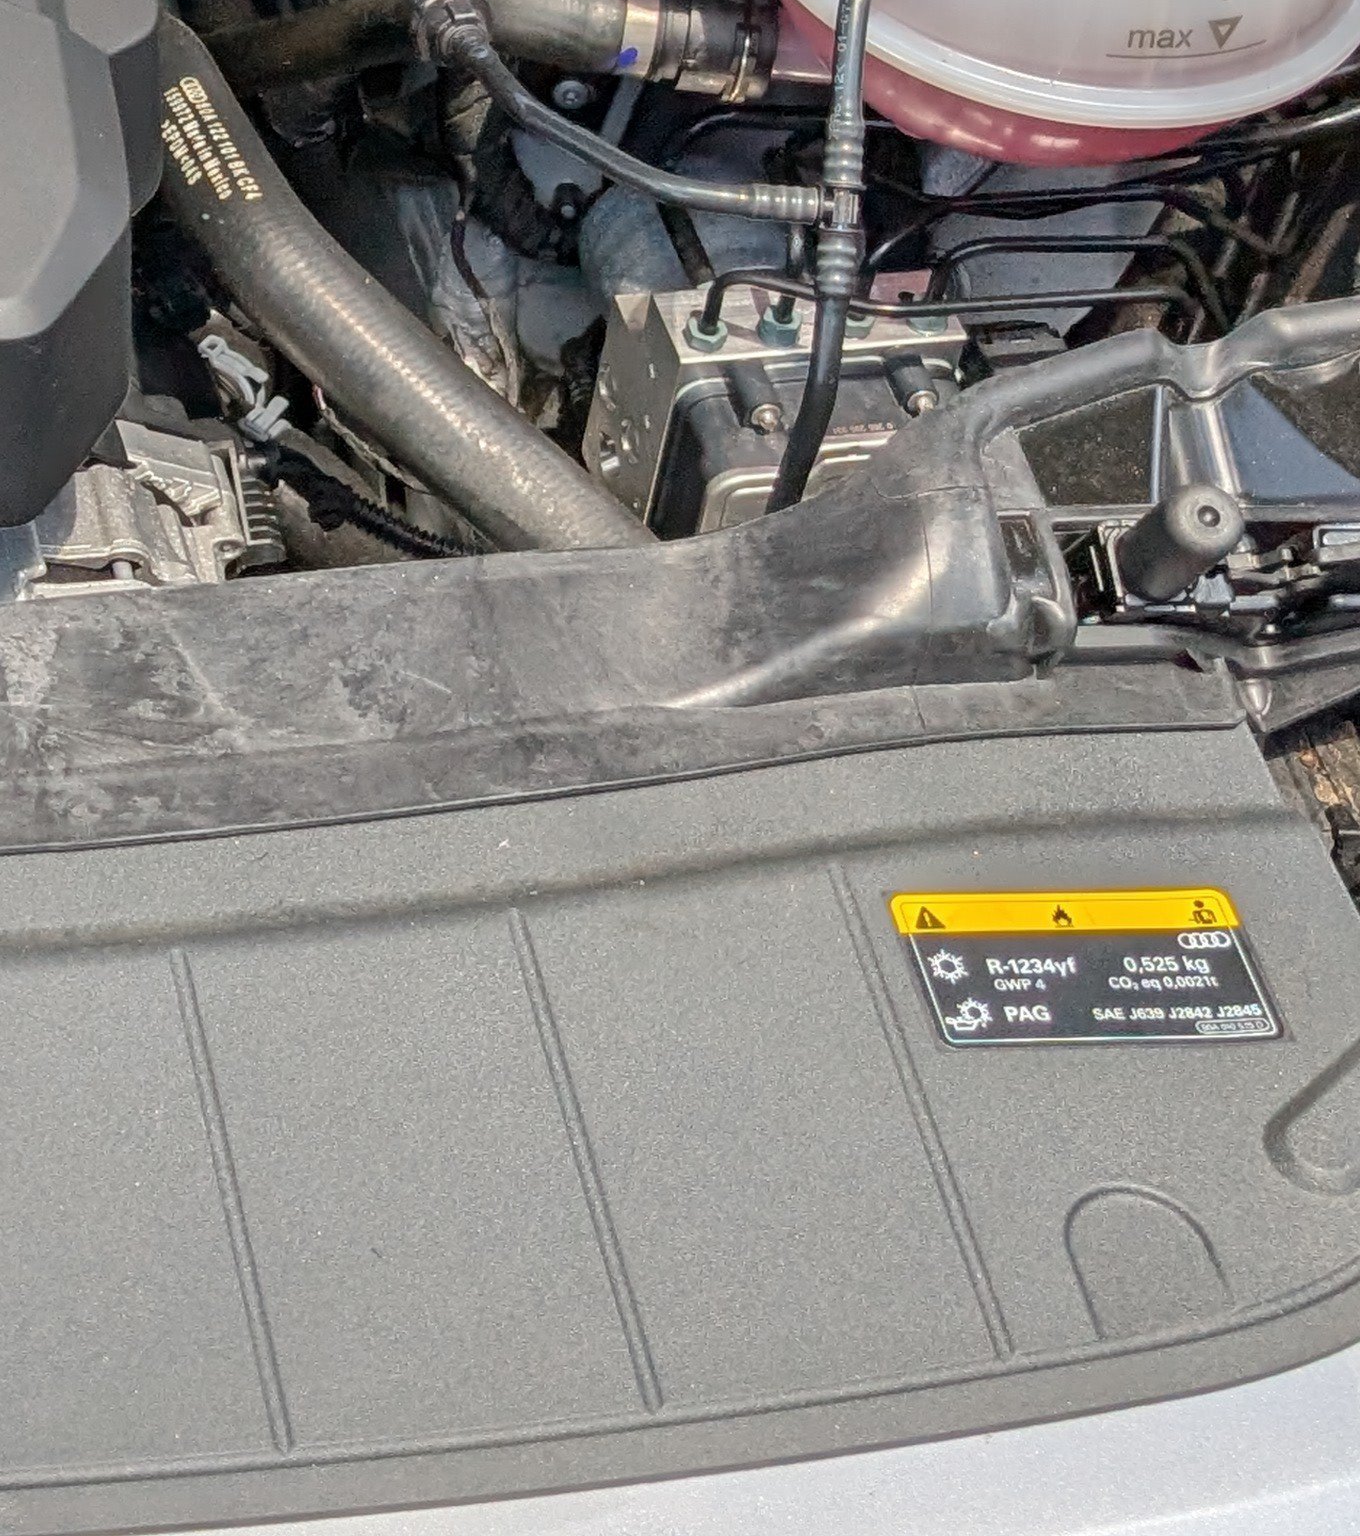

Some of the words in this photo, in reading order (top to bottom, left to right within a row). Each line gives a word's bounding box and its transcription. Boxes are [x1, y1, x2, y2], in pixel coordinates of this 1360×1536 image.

[1128, 26, 1193, 49] max
[203, 157, 233, 200] Mexico
[985, 956, 1076, 975] R-1234yf
[1123, 956, 1180, 974] 0,525
[1183, 956, 1210, 974] kg
[994, 978, 1032, 991] GWP
[1035, 978, 1046, 991] 4
[1141, 979, 1162, 992] eq
[1004, 1005, 1052, 1022] PAG
[1093, 1007, 1124, 1020] SAE
[1129, 1006, 1164, 1020] J639
[1168, 1006, 1213, 1020] J2842
[1217, 1003, 1263, 1018] J2845
